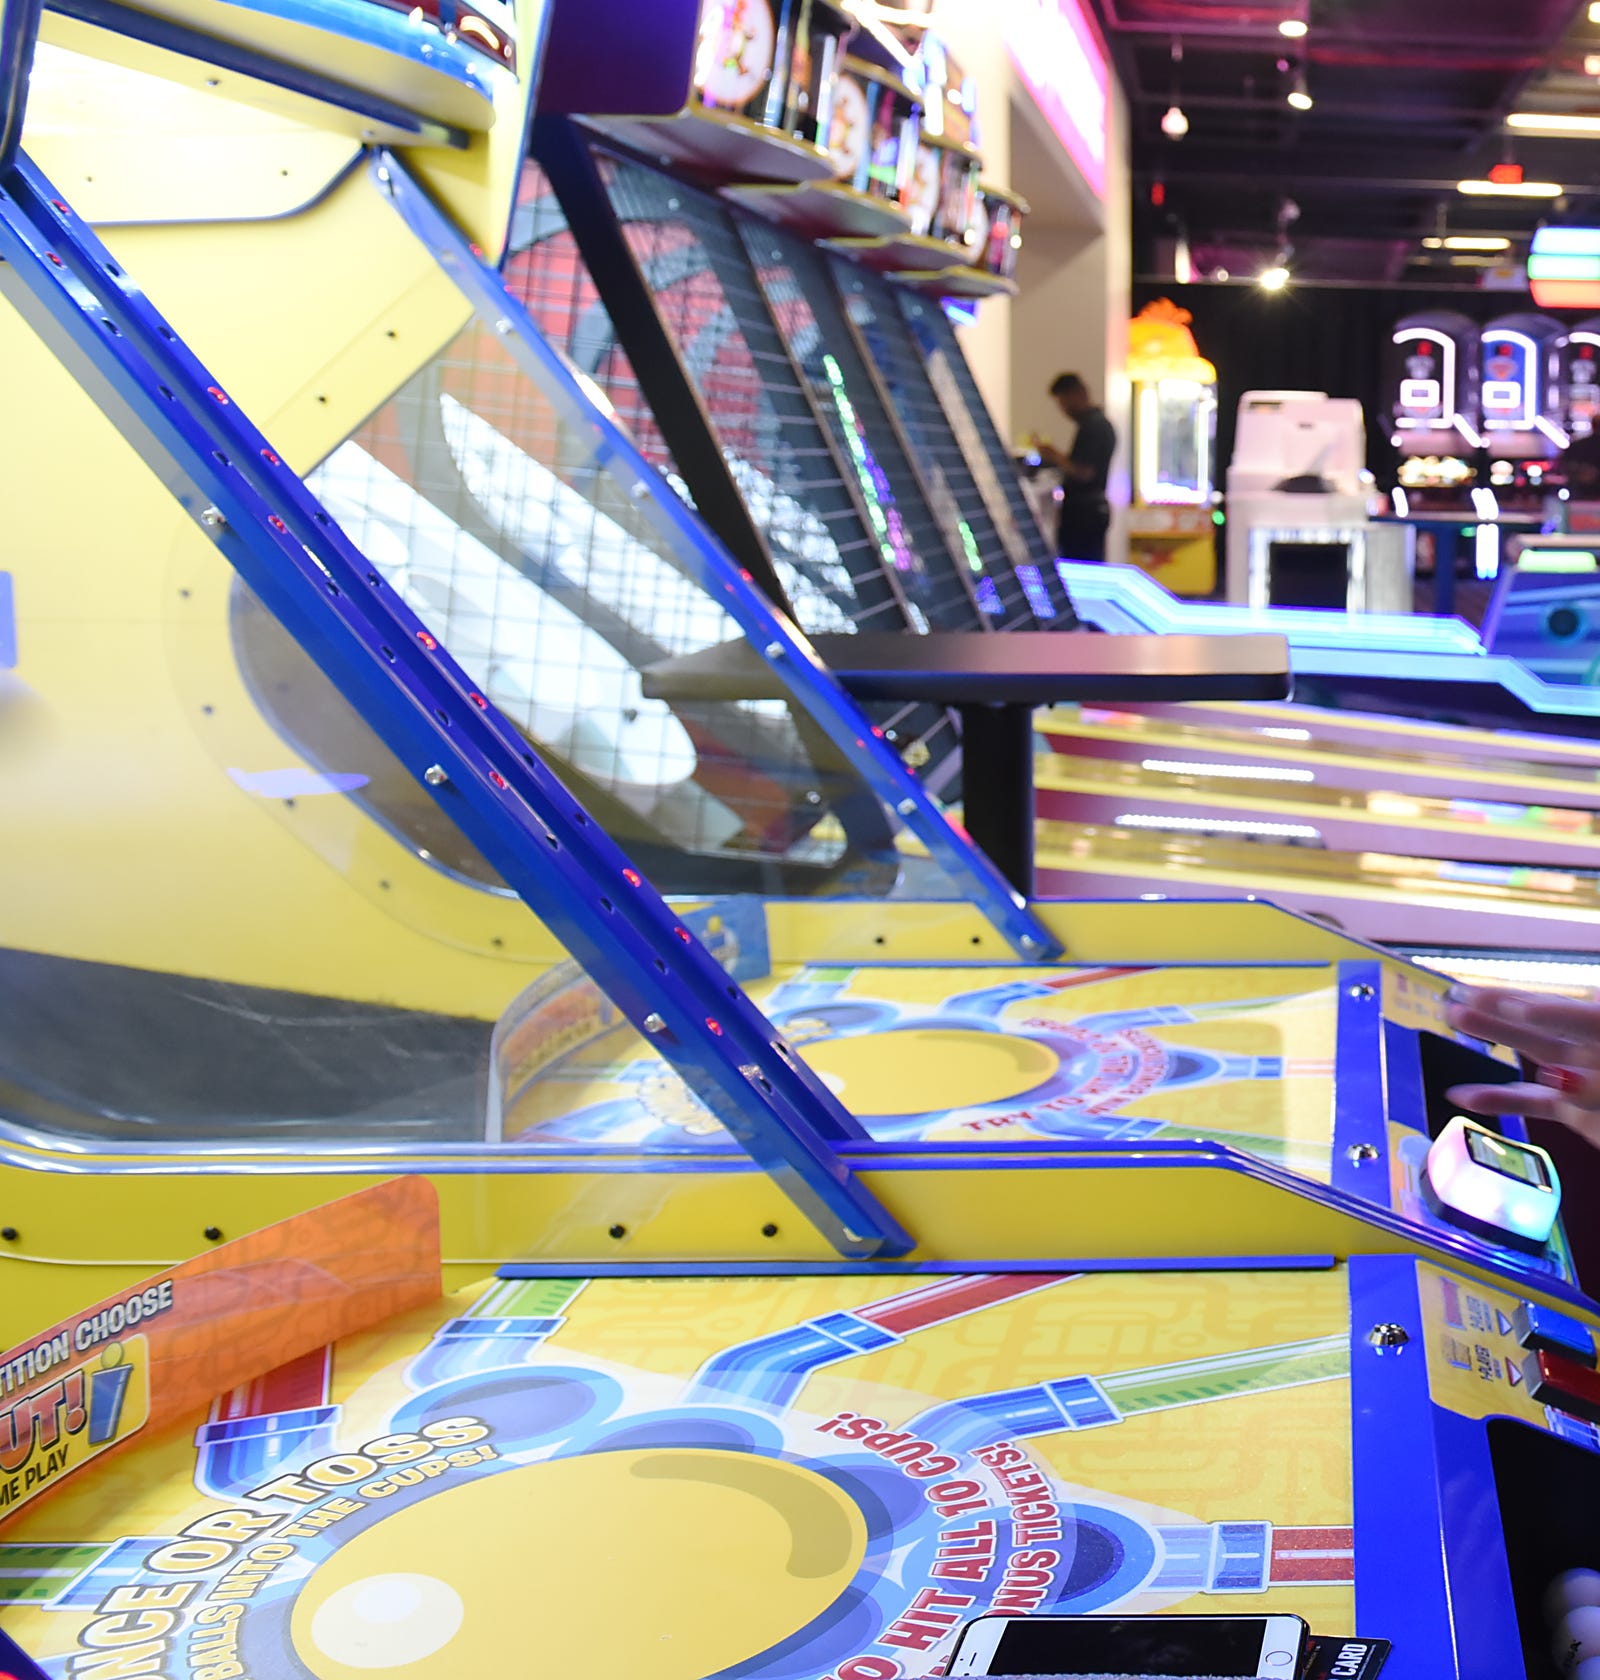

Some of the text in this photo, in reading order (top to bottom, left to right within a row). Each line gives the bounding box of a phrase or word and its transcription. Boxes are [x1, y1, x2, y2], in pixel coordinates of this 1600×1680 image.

[73, 1279, 174, 1352] CHOOSE
[25, 1444, 69, 1491] PLAY
[971, 1441, 1063, 1546] TICKETS!
[66, 1416, 496, 1680] NCE OR TOSS
[205, 1543, 296, 1601] INTO
[271, 1497, 369, 1538] THE
[357, 1444, 500, 1499] CUPS!
[814, 1412, 996, 1679] O HIT ALL 10 CUPS!
[1330, 1643, 1368, 1676] CARD
